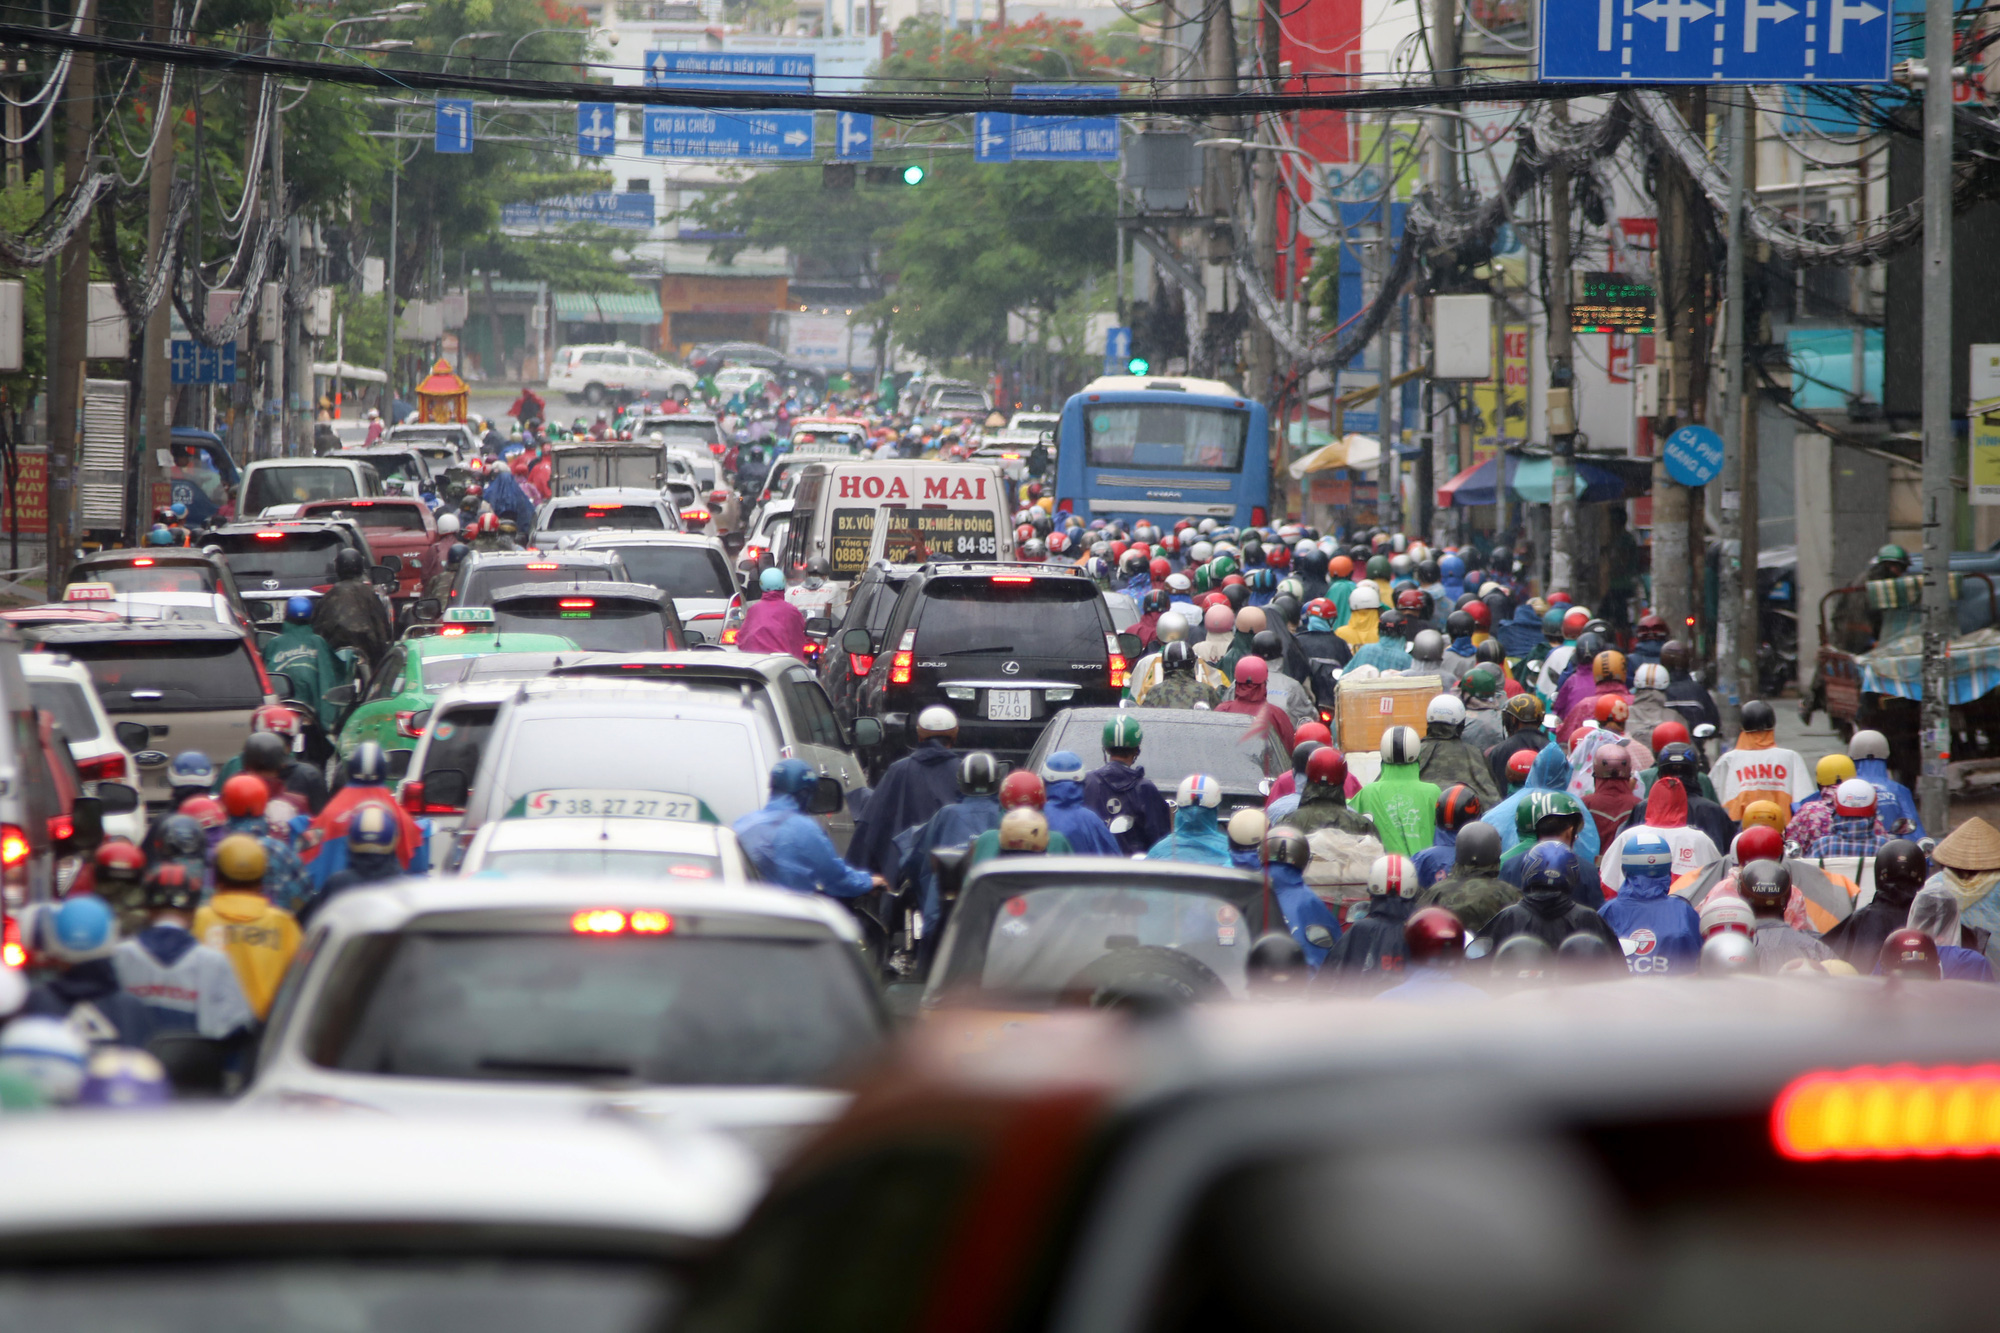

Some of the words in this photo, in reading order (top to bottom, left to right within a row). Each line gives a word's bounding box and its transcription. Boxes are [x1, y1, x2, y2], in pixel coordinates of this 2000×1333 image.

[839, 476, 910, 498] HOA
[924, 477, 987, 500] MAI
[964, 515, 994, 533] ĐÔNG
[71, 589, 106, 599] TAXI
[998, 691, 1020, 704] 51A
[989, 704, 1028, 718] 574.91
[1736, 763, 1787, 782] INNO
[565, 799, 627, 816] 38.27
[634, 800, 659, 816] 27
[665, 801, 692, 818] 27
